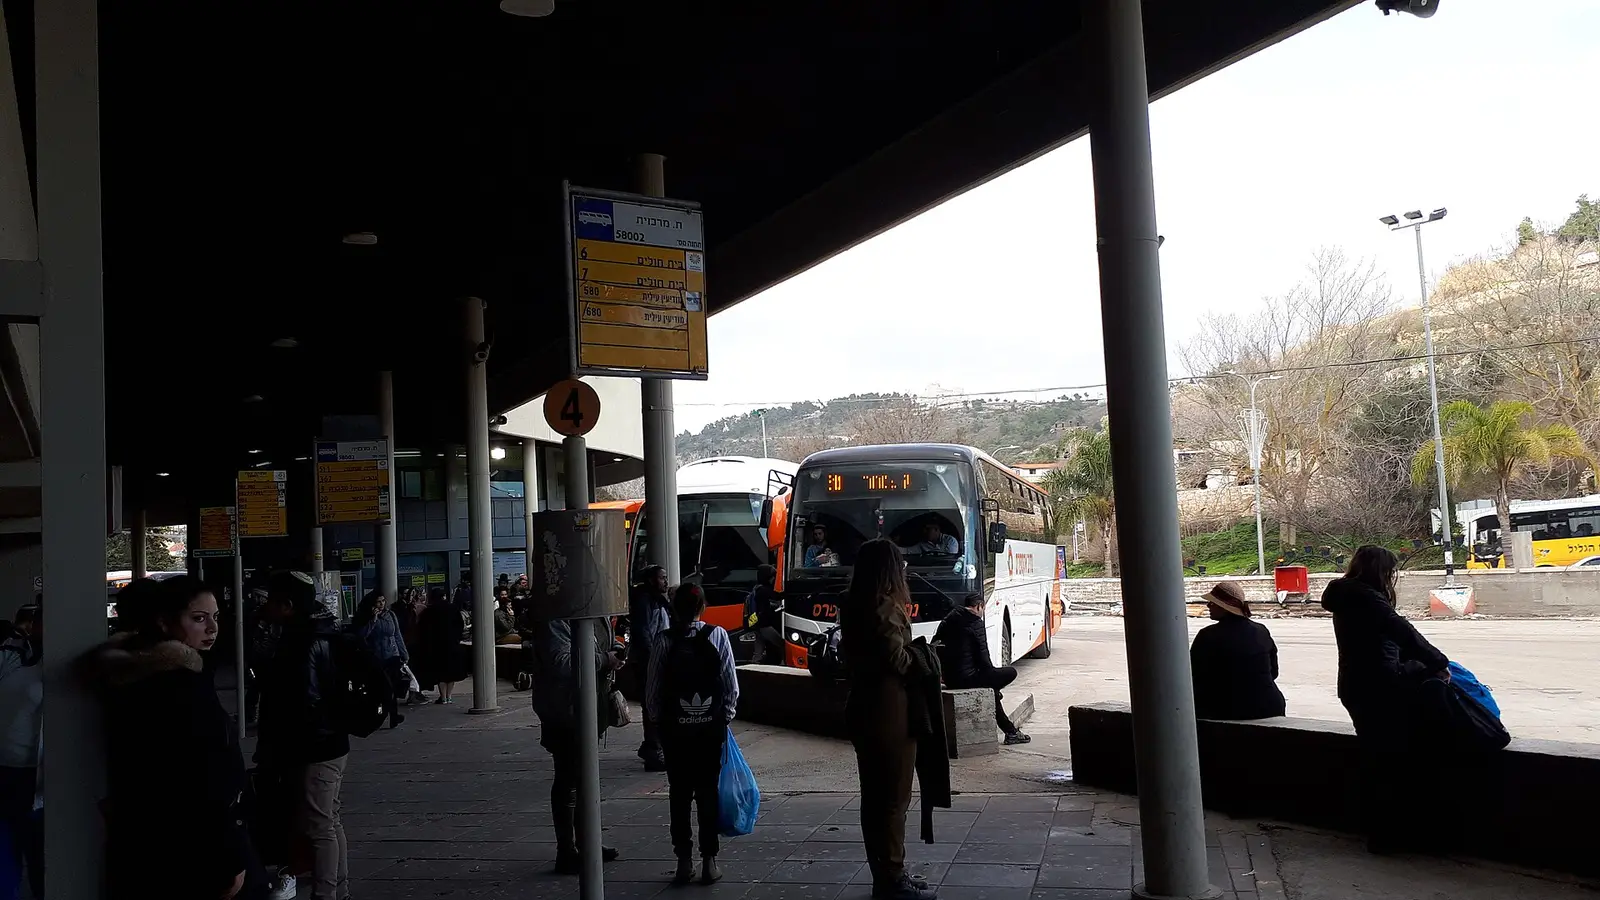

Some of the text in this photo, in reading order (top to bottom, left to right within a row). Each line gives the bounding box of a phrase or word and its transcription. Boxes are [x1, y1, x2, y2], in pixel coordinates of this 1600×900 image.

[615, 230, 645, 242] 58002
[580, 247, 588, 260] 6
[637, 255, 664, 268] חולים
[581, 268, 588, 281] 7
[636, 276, 664, 288] חולים
[583, 286, 600, 297] 580
[586, 306, 602, 317] 680
[560, 387, 584, 428] 4
[1567, 544, 1595, 554] הגליל
[678, 715, 713, 724] adidas
